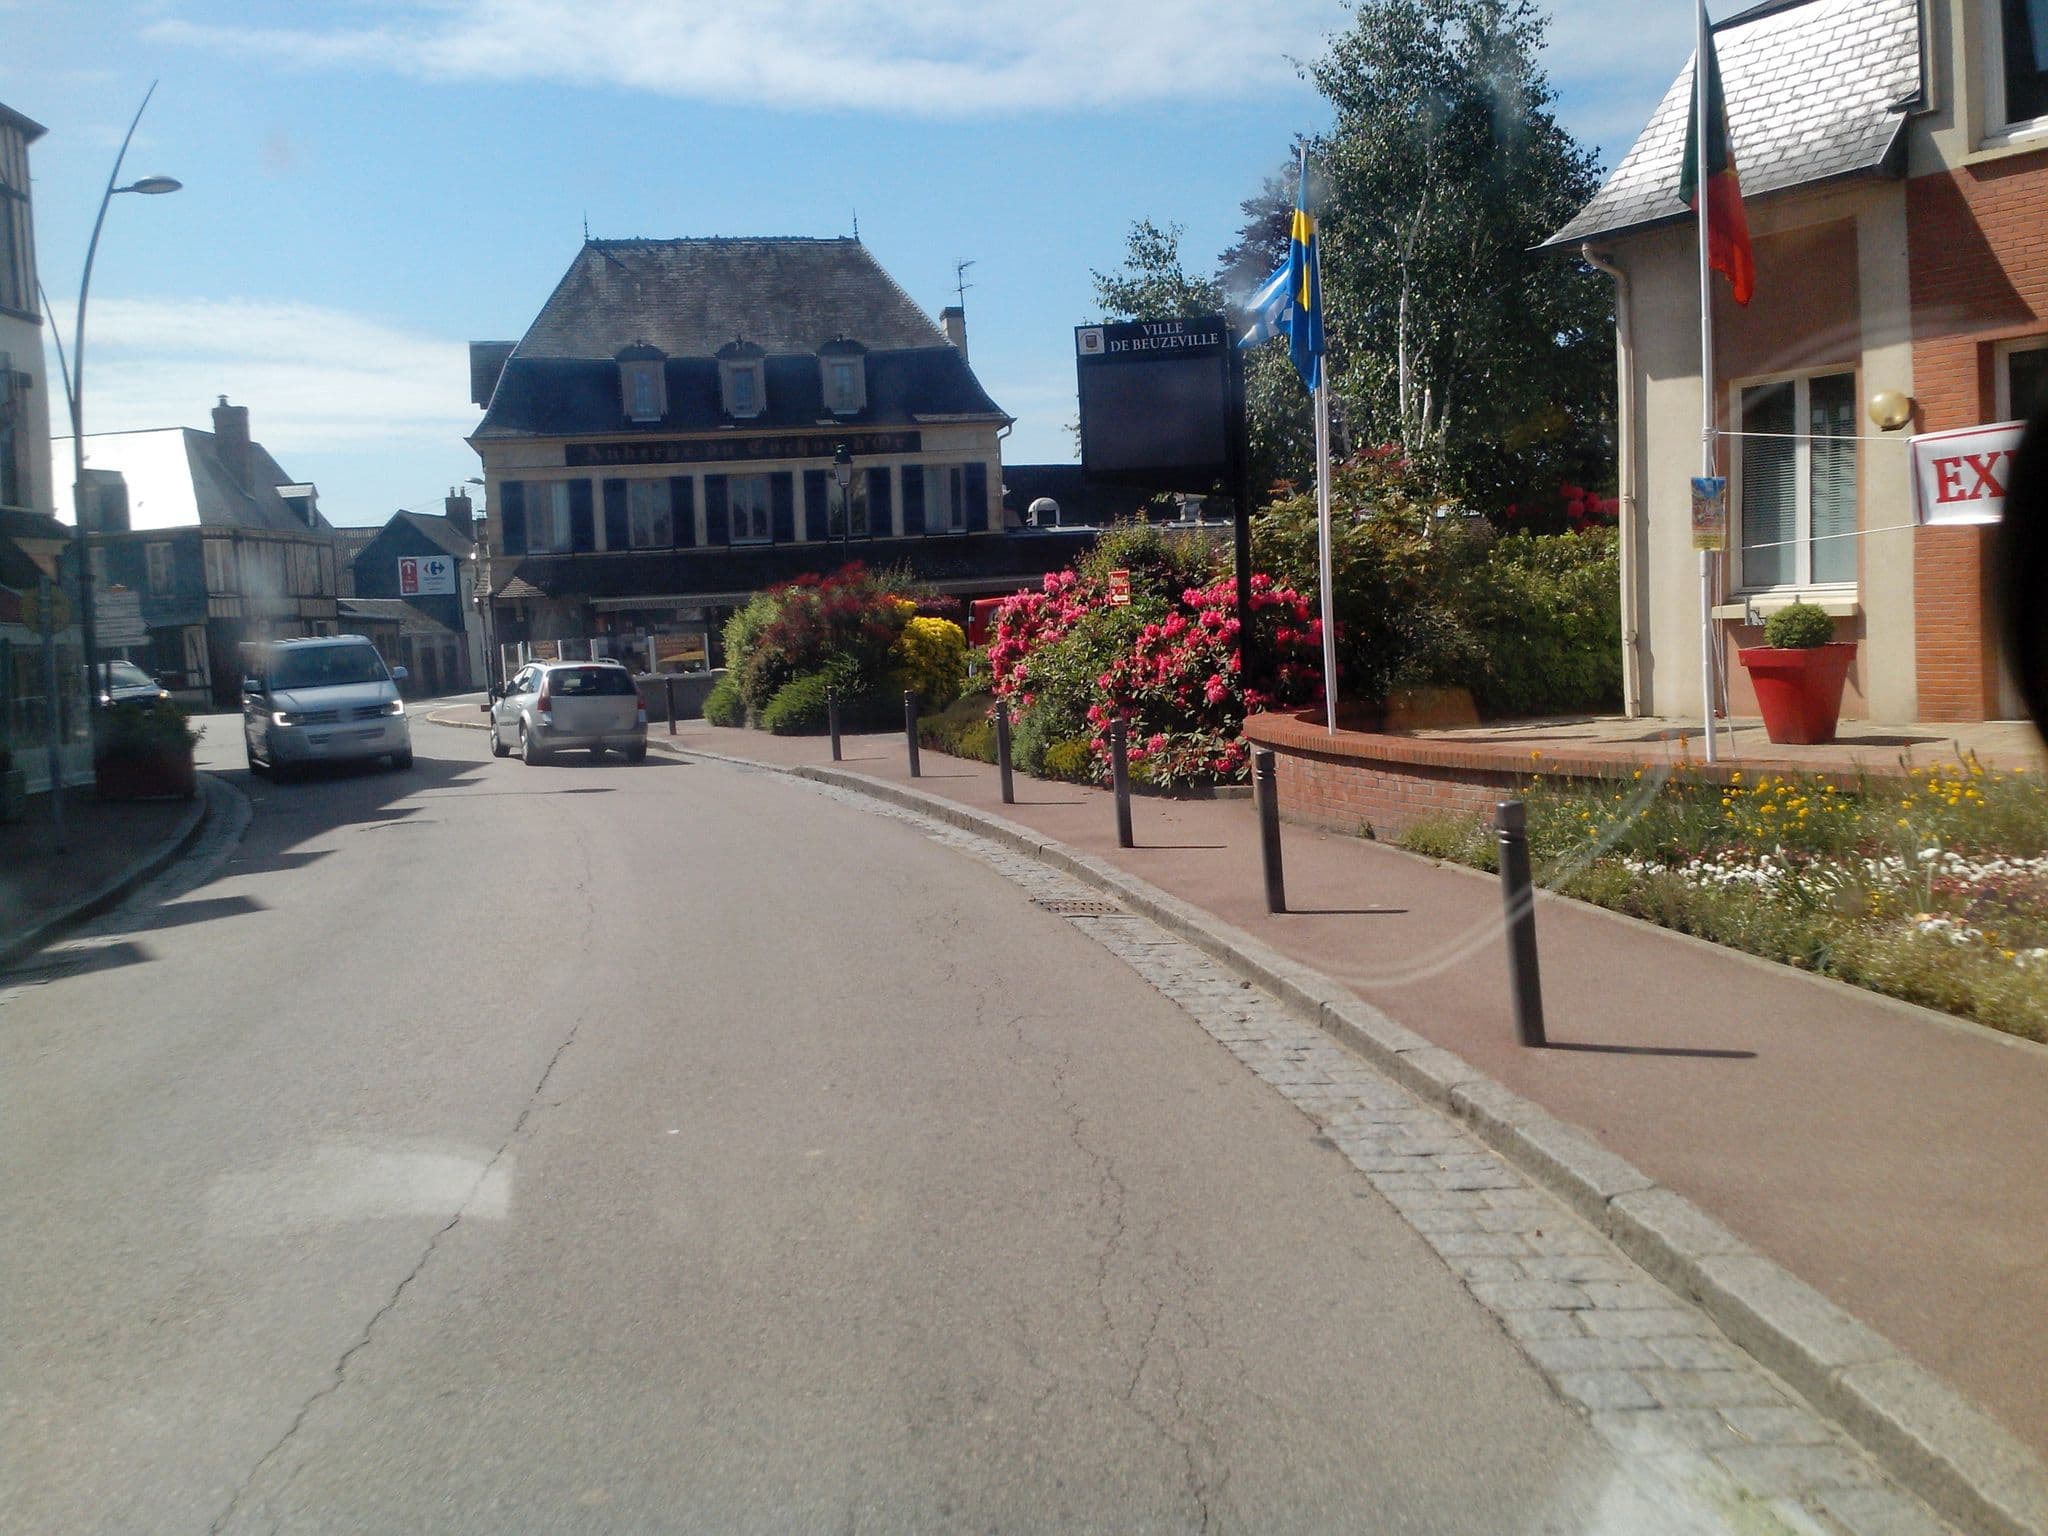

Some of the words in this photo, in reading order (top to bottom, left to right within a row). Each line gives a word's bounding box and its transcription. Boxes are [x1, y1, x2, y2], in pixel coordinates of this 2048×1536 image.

[1142, 322, 1184, 336] VILLE
[1110, 340, 1129, 352] DE
[1132, 333, 1219, 351] BEUZEVILLE
[585, 445, 696, 462] Auberge
